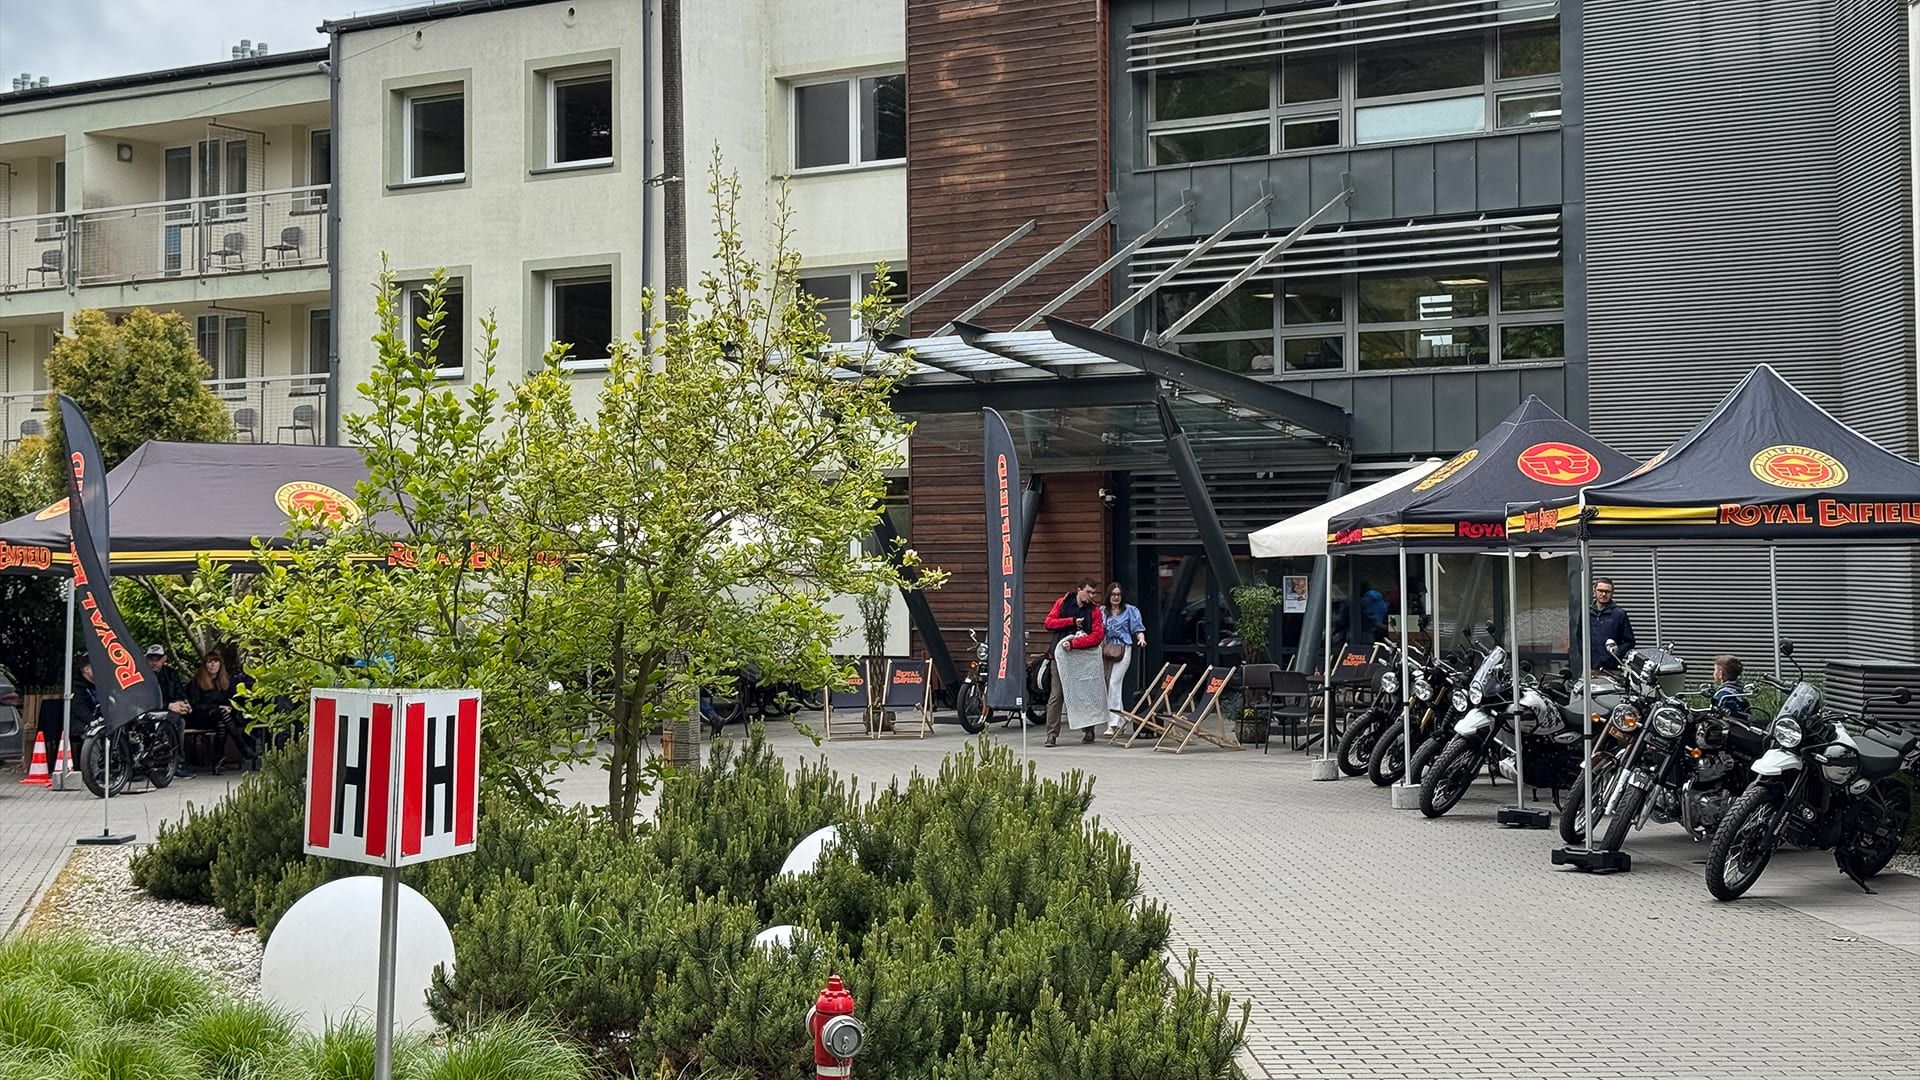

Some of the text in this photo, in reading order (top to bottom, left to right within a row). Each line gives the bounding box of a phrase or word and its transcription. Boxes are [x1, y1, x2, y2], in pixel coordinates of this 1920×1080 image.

[1458, 521, 1505, 539] ROYA
[1719, 503, 1814, 527] ROYAL
[0, 541, 51, 570] ENFIELD
[998, 454, 1013, 679] ROYAL ENFIELD
[81, 591, 144, 690] ROYAL
[895, 669, 920, 677] ROYAL
[334, 715, 369, 838] H
[425, 715, 455, 836] H
